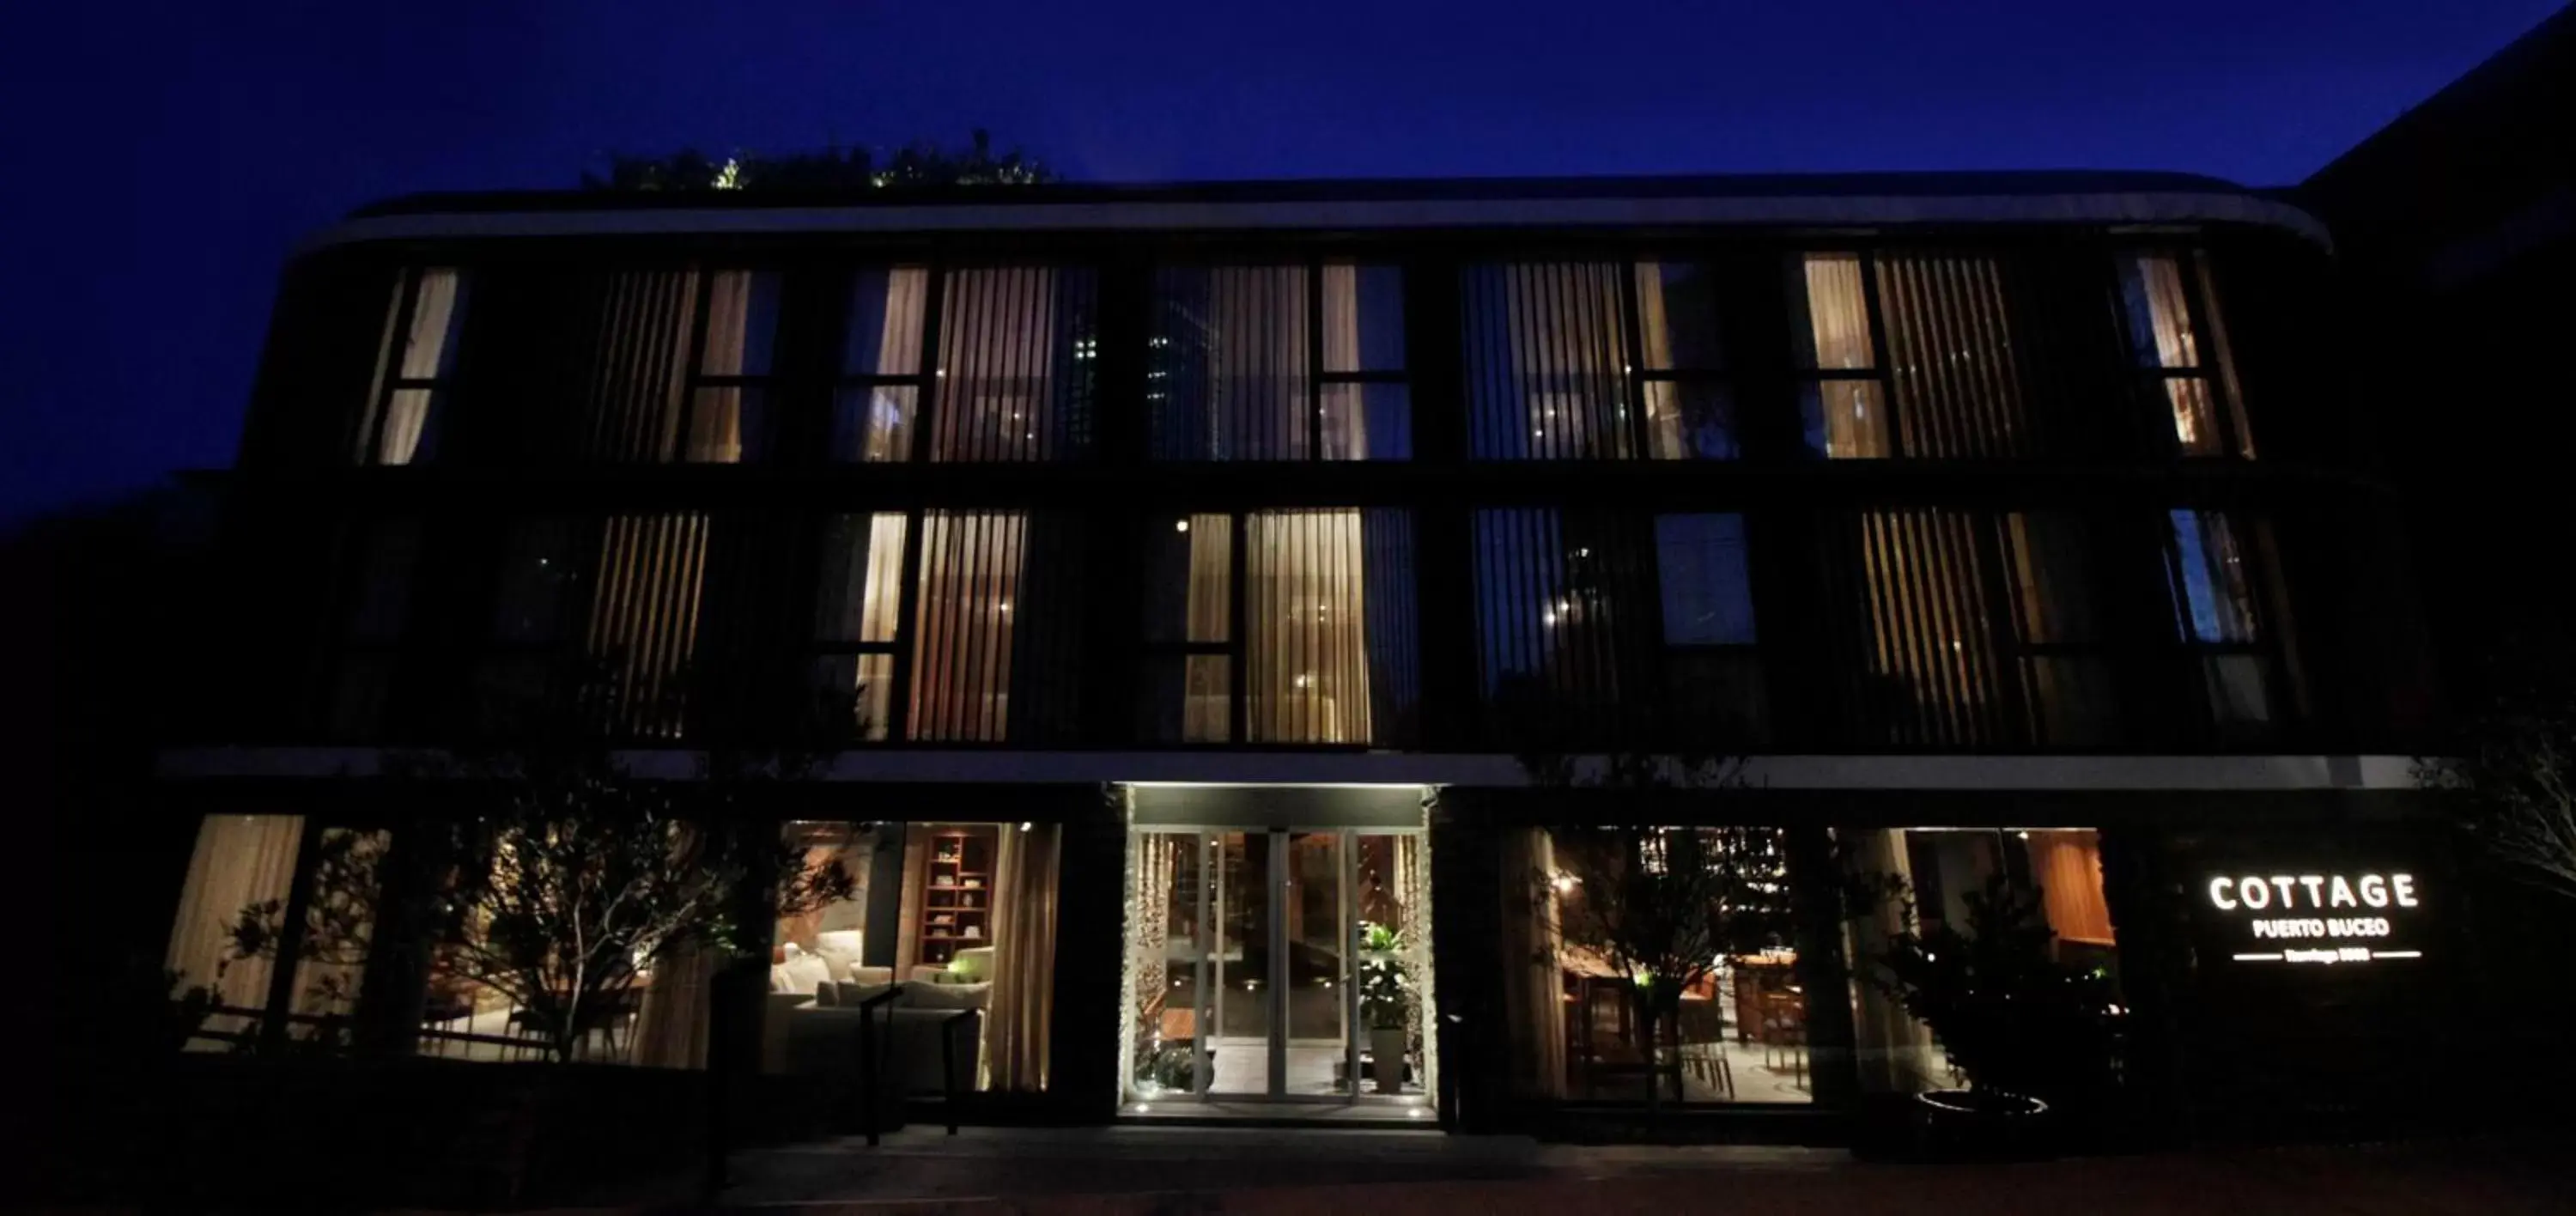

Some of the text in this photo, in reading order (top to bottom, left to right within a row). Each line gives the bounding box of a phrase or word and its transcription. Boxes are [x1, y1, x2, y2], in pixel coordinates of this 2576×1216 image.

[2210, 874, 2418, 909] COTTAGE
[2252, 918, 2390, 938] PUERTO BUCEO
